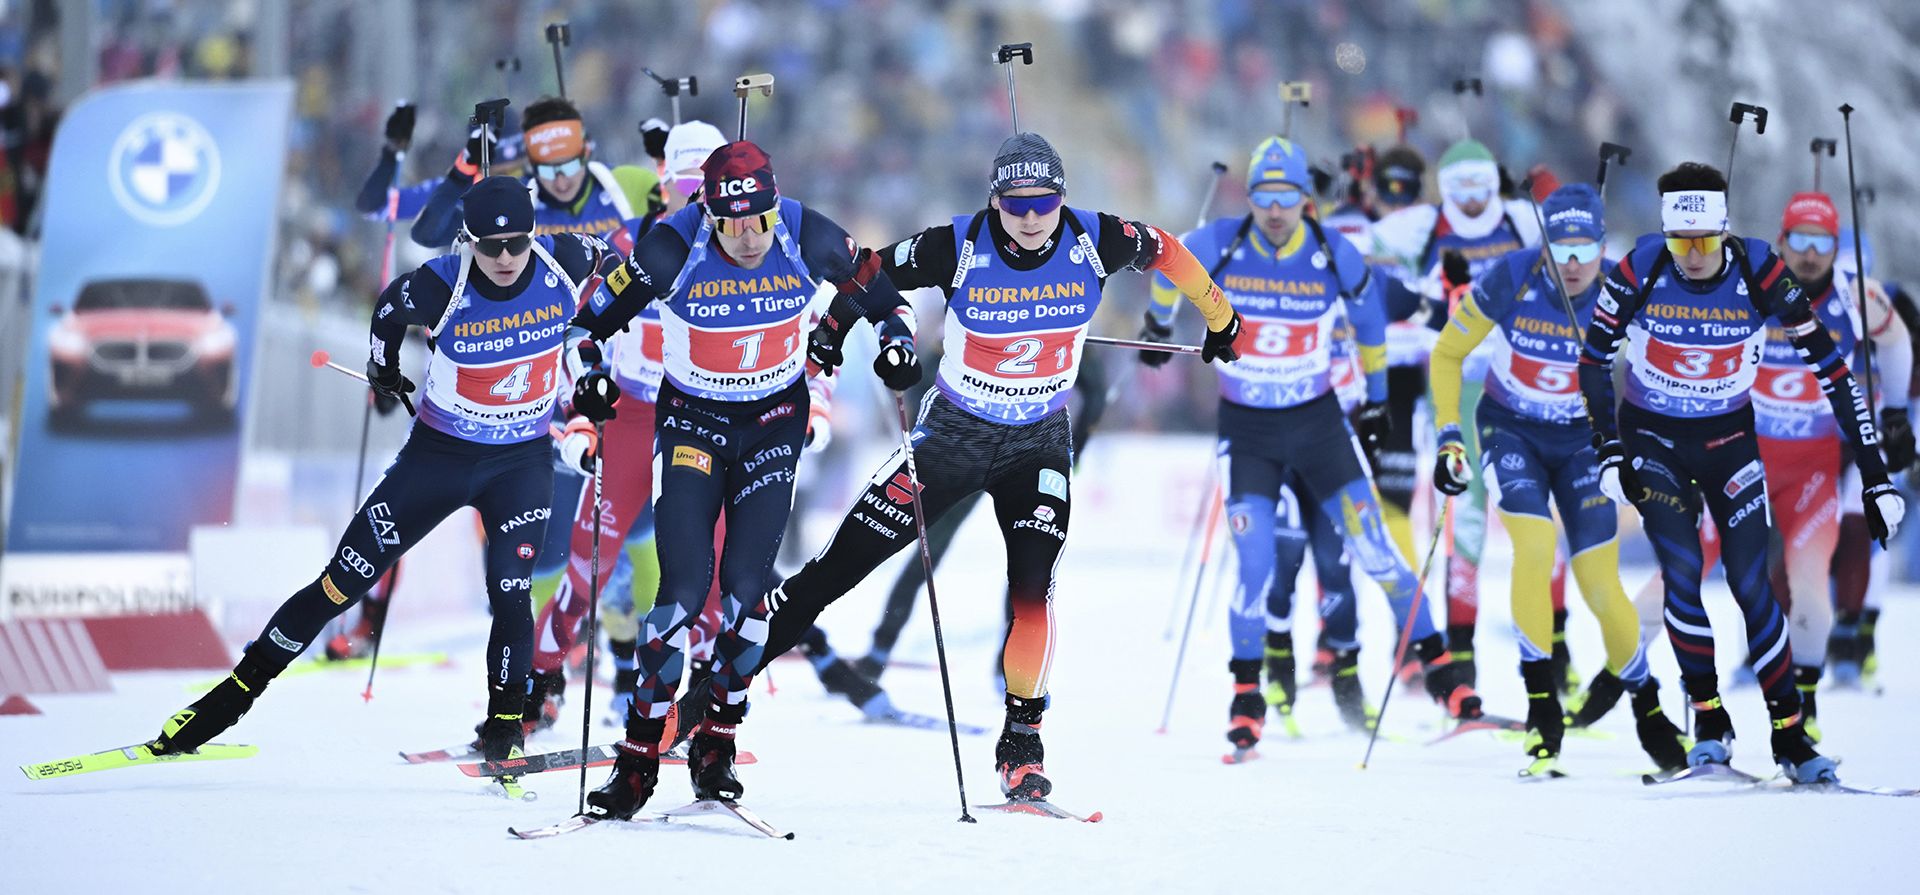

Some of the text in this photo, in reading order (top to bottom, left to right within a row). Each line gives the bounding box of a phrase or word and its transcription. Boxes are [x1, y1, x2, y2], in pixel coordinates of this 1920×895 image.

[997, 162, 1052, 181] BIOTEAQUE
[719, 176, 757, 197] ice
[1679, 195, 1705, 203] GREEN
[1681, 204, 1706, 213] WEEZ
[953, 242, 972, 286] robotron
[1080, 236, 1104, 275] robotron
[688, 274, 803, 300] HÖRMANN
[968, 281, 1085, 304] HÖRMANN
[687, 295, 806, 317] Tore Türen
[966, 303, 1086, 323] Garage Doors
[1646, 303, 1749, 321] HÖRMANN
[454, 302, 563, 337] HÖRMANN
[1645, 318, 1683, 335] Tore
[1701, 323, 1750, 337] Türen
[453, 324, 564, 354] Garage Doors
[732, 331, 797, 370] 1 1
[1254, 323, 1292, 354] 8
[1510, 330, 1546, 350] Tore
[995, 337, 1067, 374] 2 1
[1673, 349, 1737, 377] 3 1
[490, 361, 553, 401] 4 1
[1535, 365, 1571, 392] 5
[1772, 371, 1805, 398] 6
[759, 405, 793, 422] MENY
[676, 451, 695, 460] Uno
[733, 471, 783, 505] CRAFT
[863, 491, 914, 526] WÜRTH
[1728, 493, 1766, 528] CRAFT
[370, 502, 400, 544] EA7
[864, 515, 899, 540] TERREX
[39, 759, 84, 776] FISCHER
